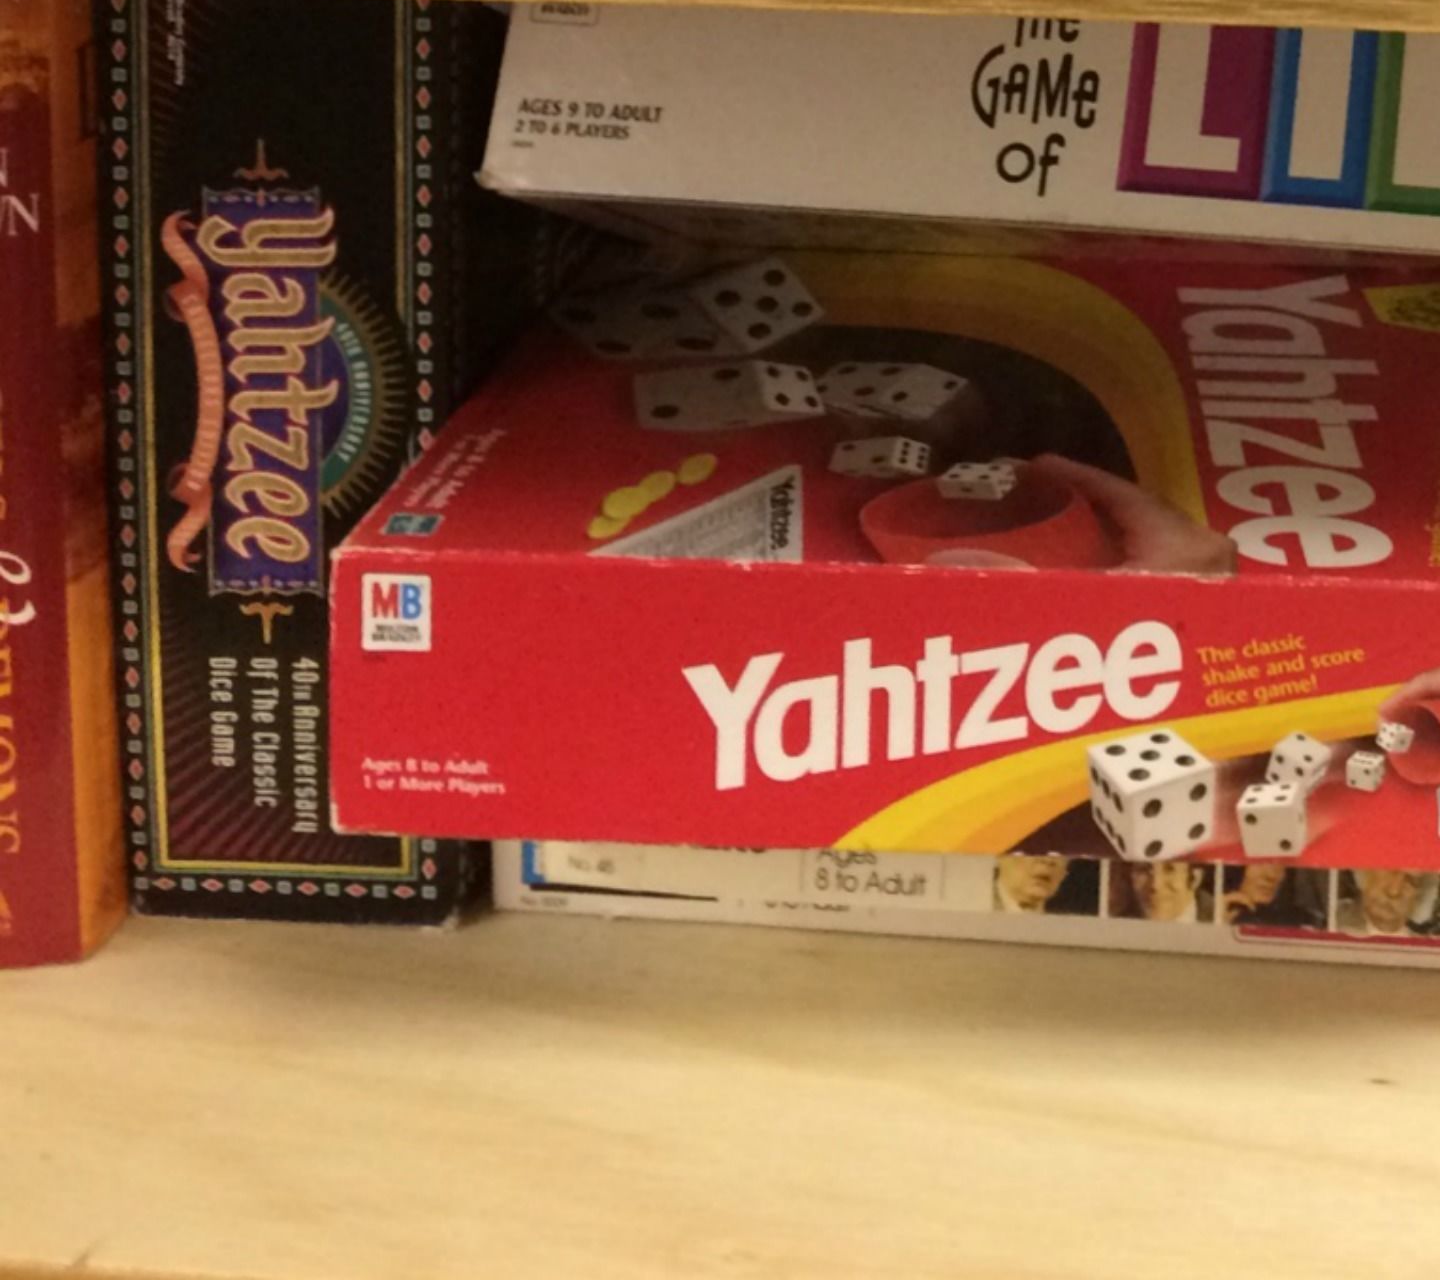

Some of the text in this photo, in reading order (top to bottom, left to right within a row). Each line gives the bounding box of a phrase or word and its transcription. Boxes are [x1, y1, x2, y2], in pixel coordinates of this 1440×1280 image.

[518, 98, 663, 123] AGES 9 TO ADULT
[529, 119, 547, 134] TO
[565, 122, 630, 140] PLAYERS
[198, 207, 338, 562] Yahtzee
[1176, 274, 1393, 568] Yahtzee
[372, 582, 422, 620] MB
[1197, 633, 1306, 665] The classic
[1202, 648, 1366, 686] shake and score
[681, 620, 1184, 791] Yahtzee
[1206, 674, 1318, 708] dice game!
[209, 657, 239, 767] Dice Game
[246, 657, 280, 808] Of The Classic
[291, 705, 320, 832] Anniversary
[361, 757, 401, 775] Ages
[422, 759, 440, 773] to
[444, 759, 489, 775] Adult
[376, 778, 395, 790] or
[401, 776, 444, 791] More
[448, 778, 506, 797] Players
[814, 868, 927, 896] 8 to Adult
